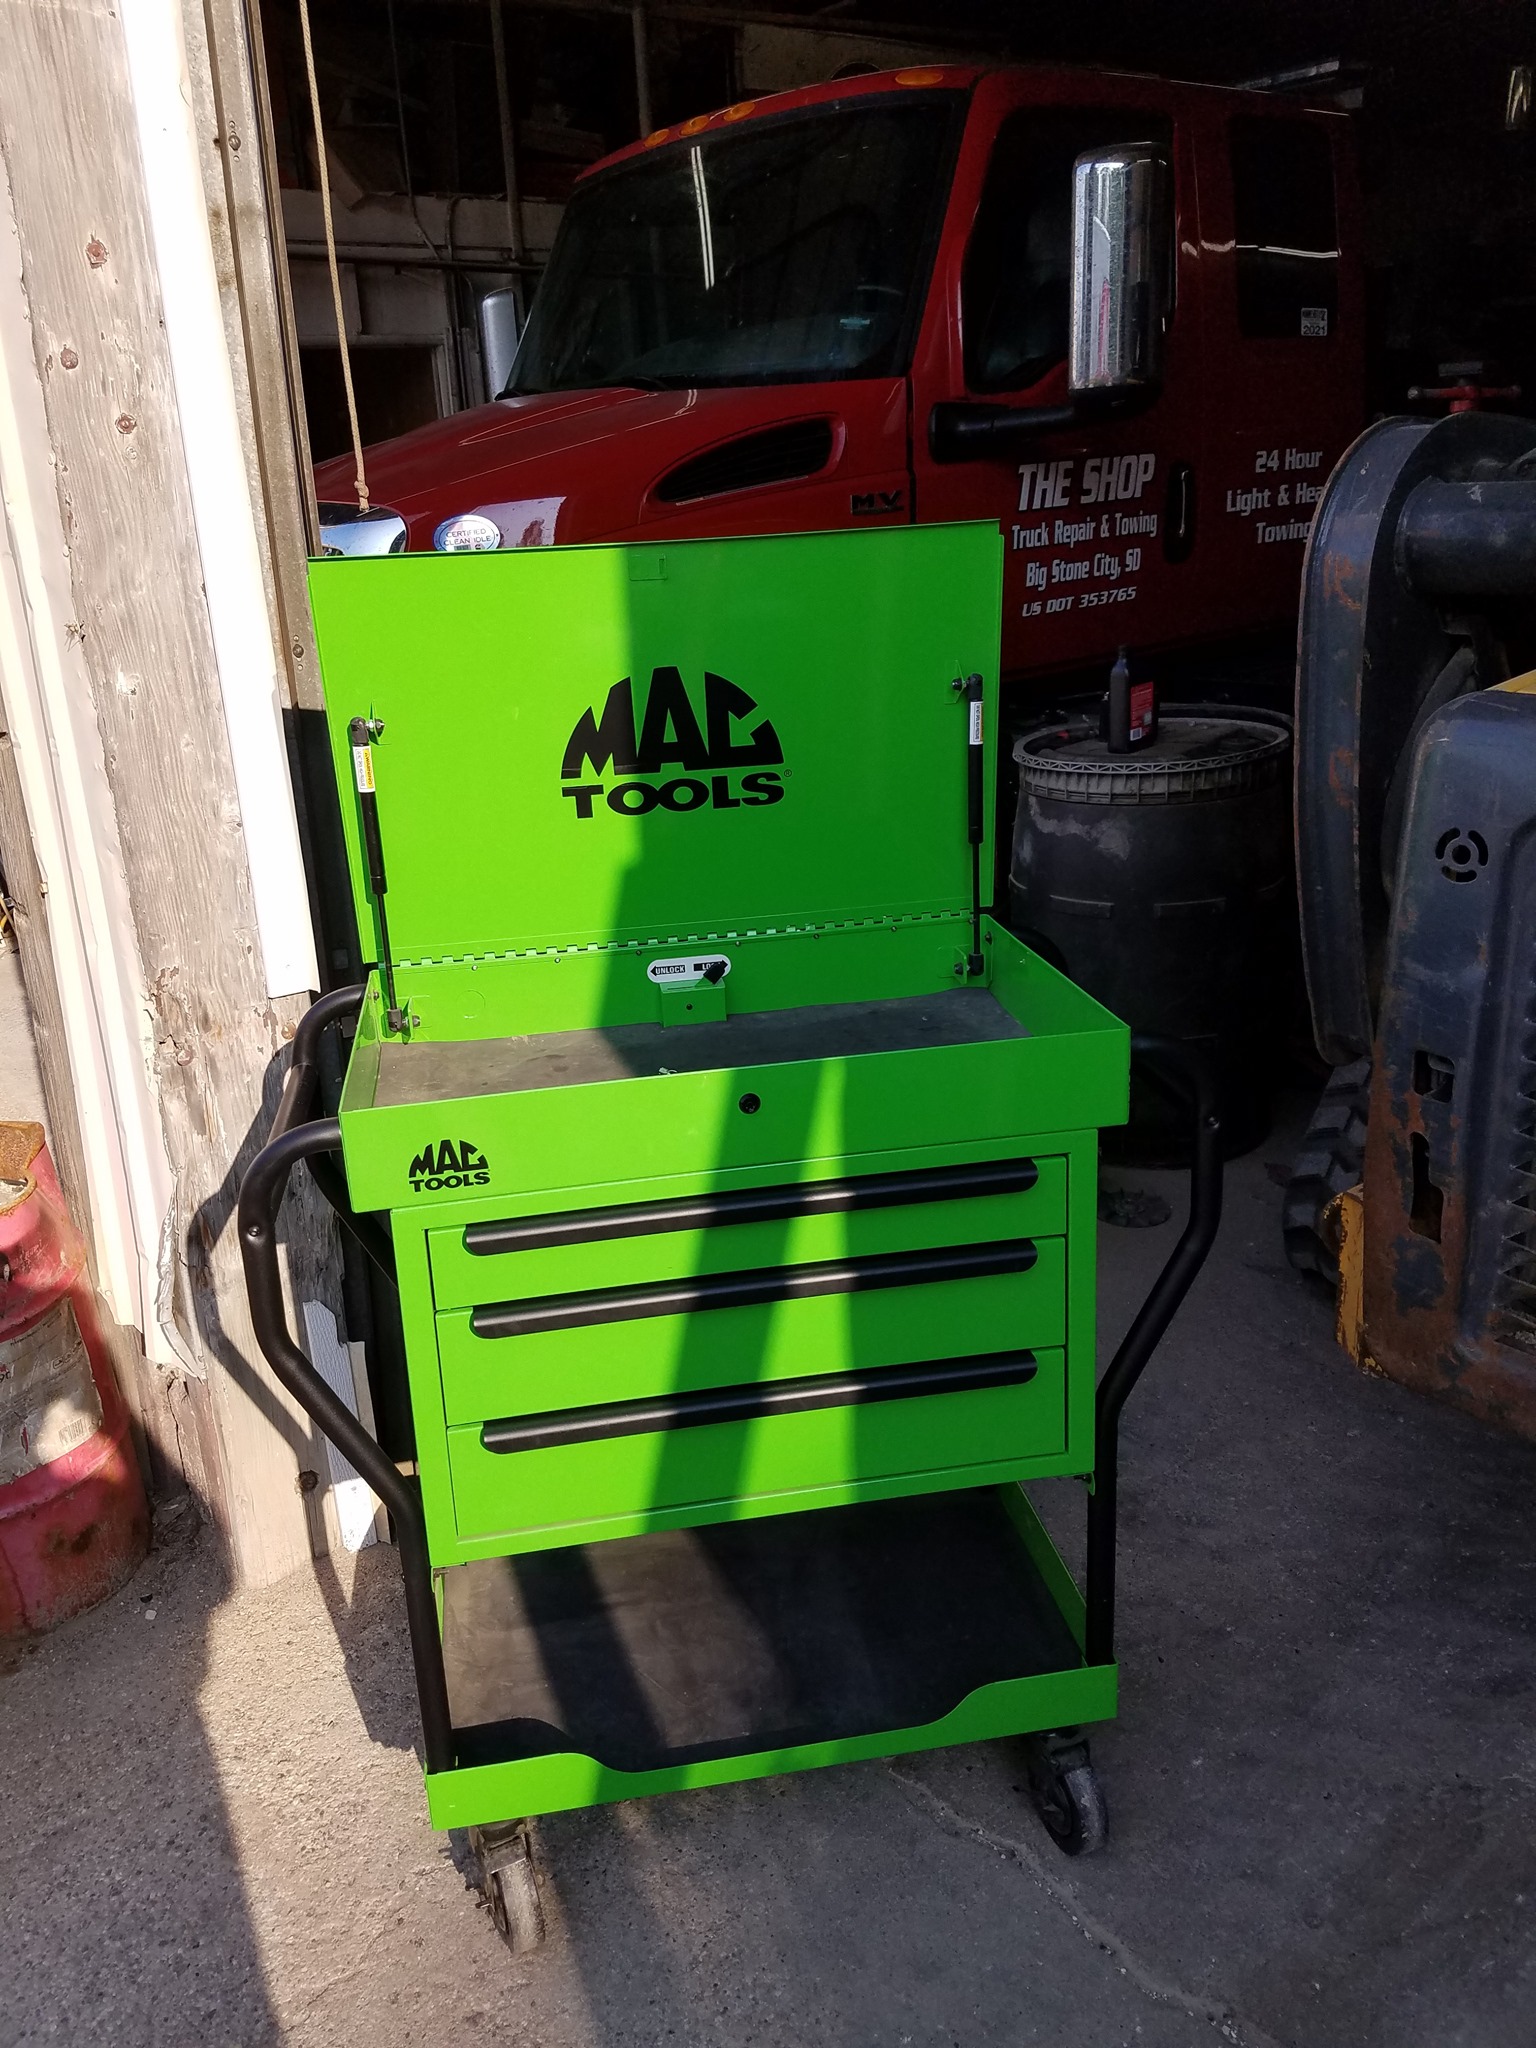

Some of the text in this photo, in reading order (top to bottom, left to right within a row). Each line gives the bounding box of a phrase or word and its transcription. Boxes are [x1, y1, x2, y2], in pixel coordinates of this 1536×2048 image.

[1302, 325, 1326, 335] 2021
[1255, 447, 1323, 473] 24 Hour
[1018, 453, 1155, 511] THE SHOP
[850, 489, 903, 512] MV
[1226, 482, 1324, 516] Light & Hea
[443, 537, 471, 547] CLEAN
[473, 535, 492, 544] IDLE
[445, 528, 487, 538] CERTIFIED
[1011, 510, 1158, 550] Truck Repair & Towing
[1026, 548, 1141, 591] Big Stone City, SD
[1022, 586, 1137, 617] US DOT 353765
[560, 665, 785, 780] MAC
[561, 771, 785, 819] TOOLS
[655, 965, 685, 976] UNLOCK
[408, 1138, 490, 1178] MAC
[408, 1171, 491, 1193] TOOLS
